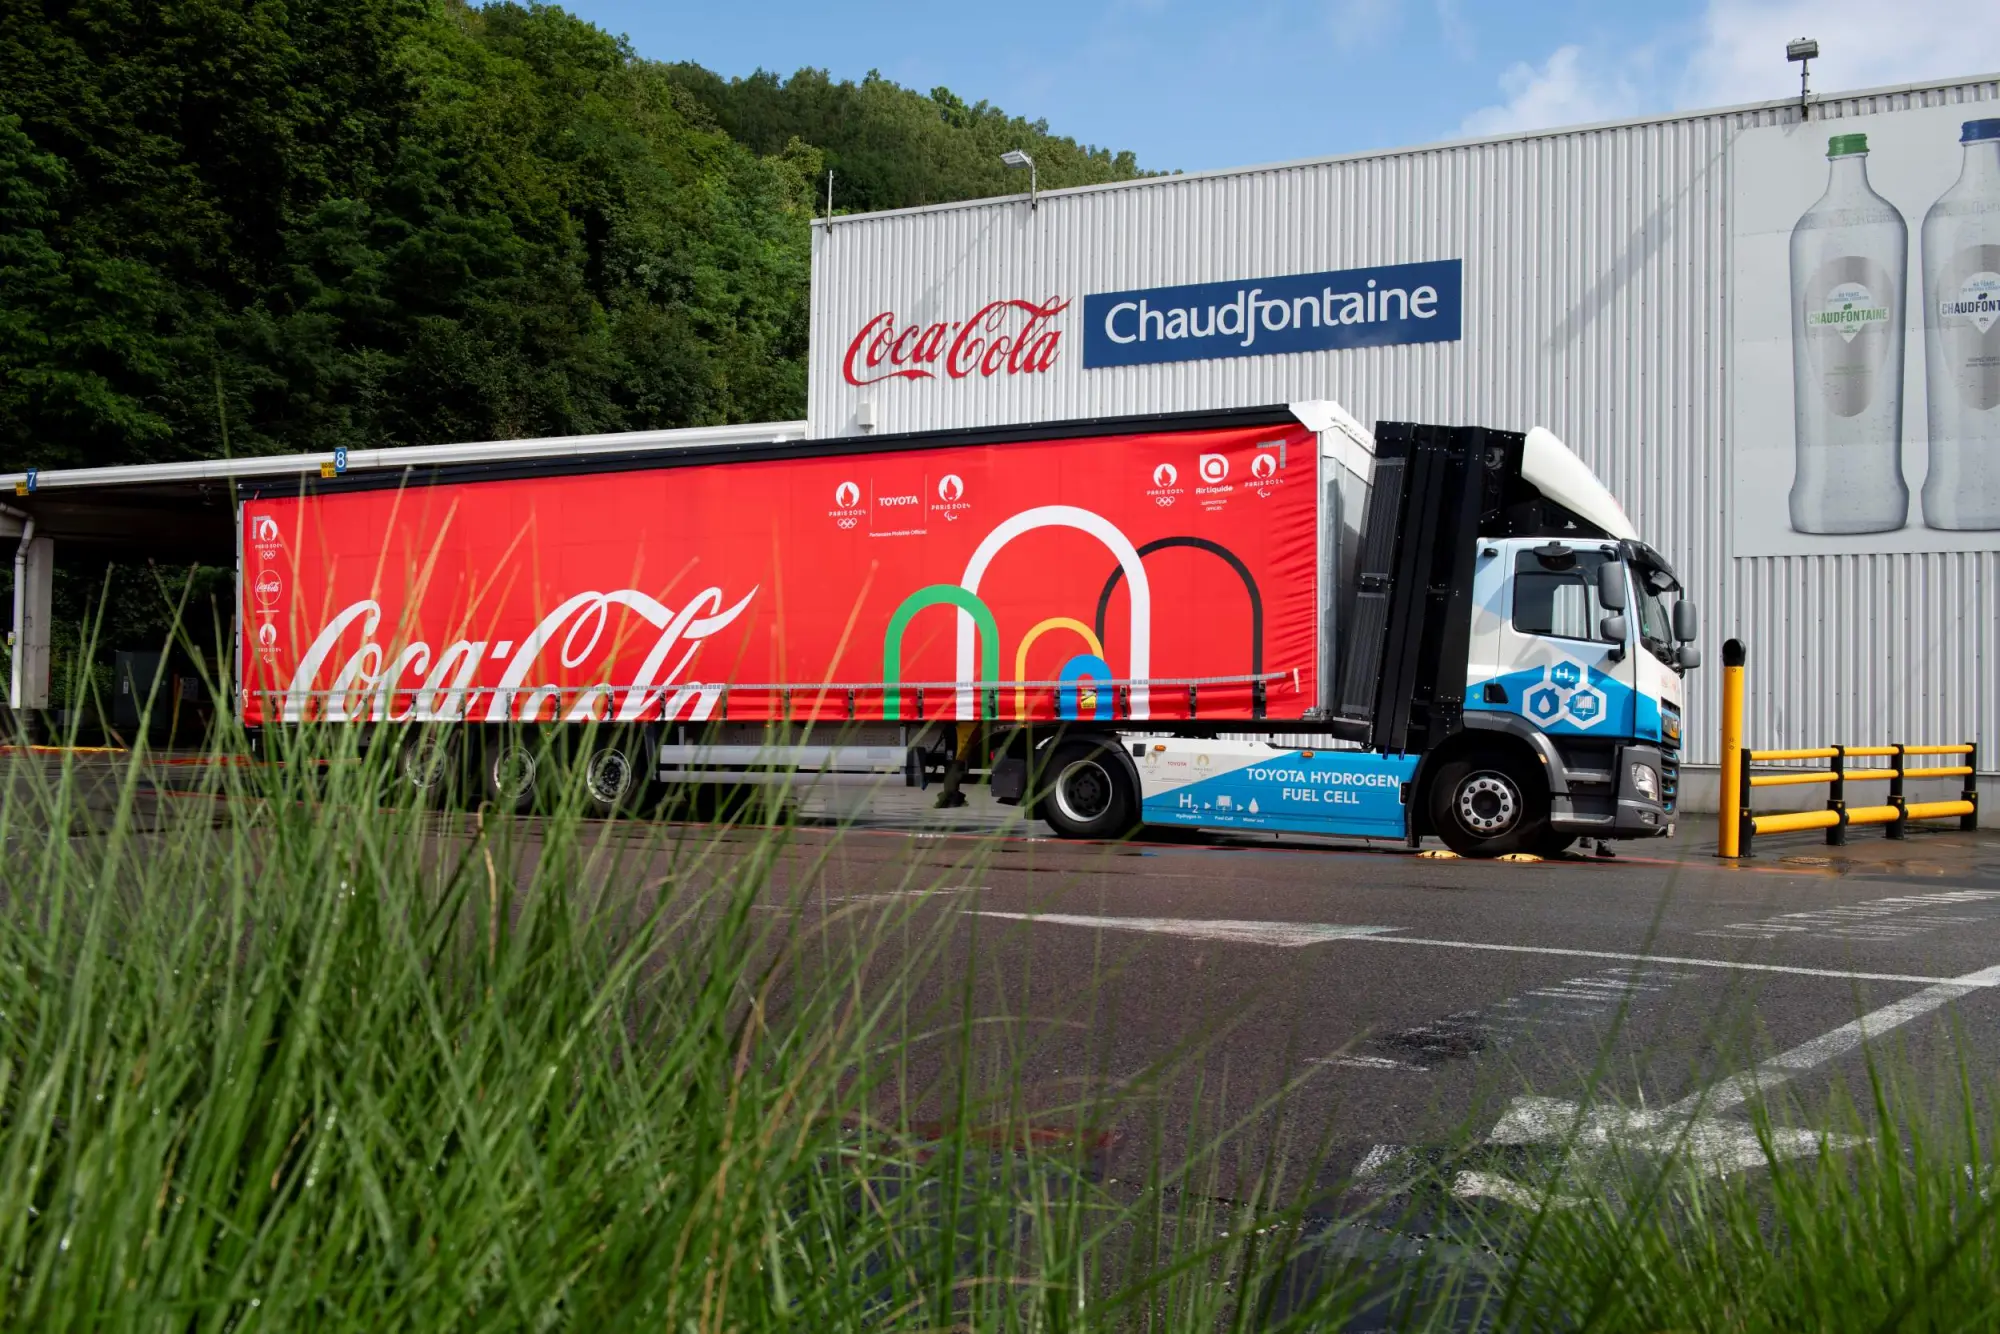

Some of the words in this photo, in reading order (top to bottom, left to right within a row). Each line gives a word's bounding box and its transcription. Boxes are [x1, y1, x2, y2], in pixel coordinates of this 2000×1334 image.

[1104, 279, 1438, 346] Chaudfontaine
[1809, 308, 1888, 324] CHAUDFONTAINE
[842, 295, 1073, 386] Coca-Cola
[336, 451, 345, 468] 8
[28, 472, 35, 487] 7
[879, 495, 918, 506] TOYOTA
[931, 503, 951, 511] PARIS
[1246, 768, 1306, 783] TOYOTA
[1310, 771, 1399, 788] HYDROGEN
[1283, 788, 1319, 802] FUEL
[1323, 790, 1360, 804] CELL
